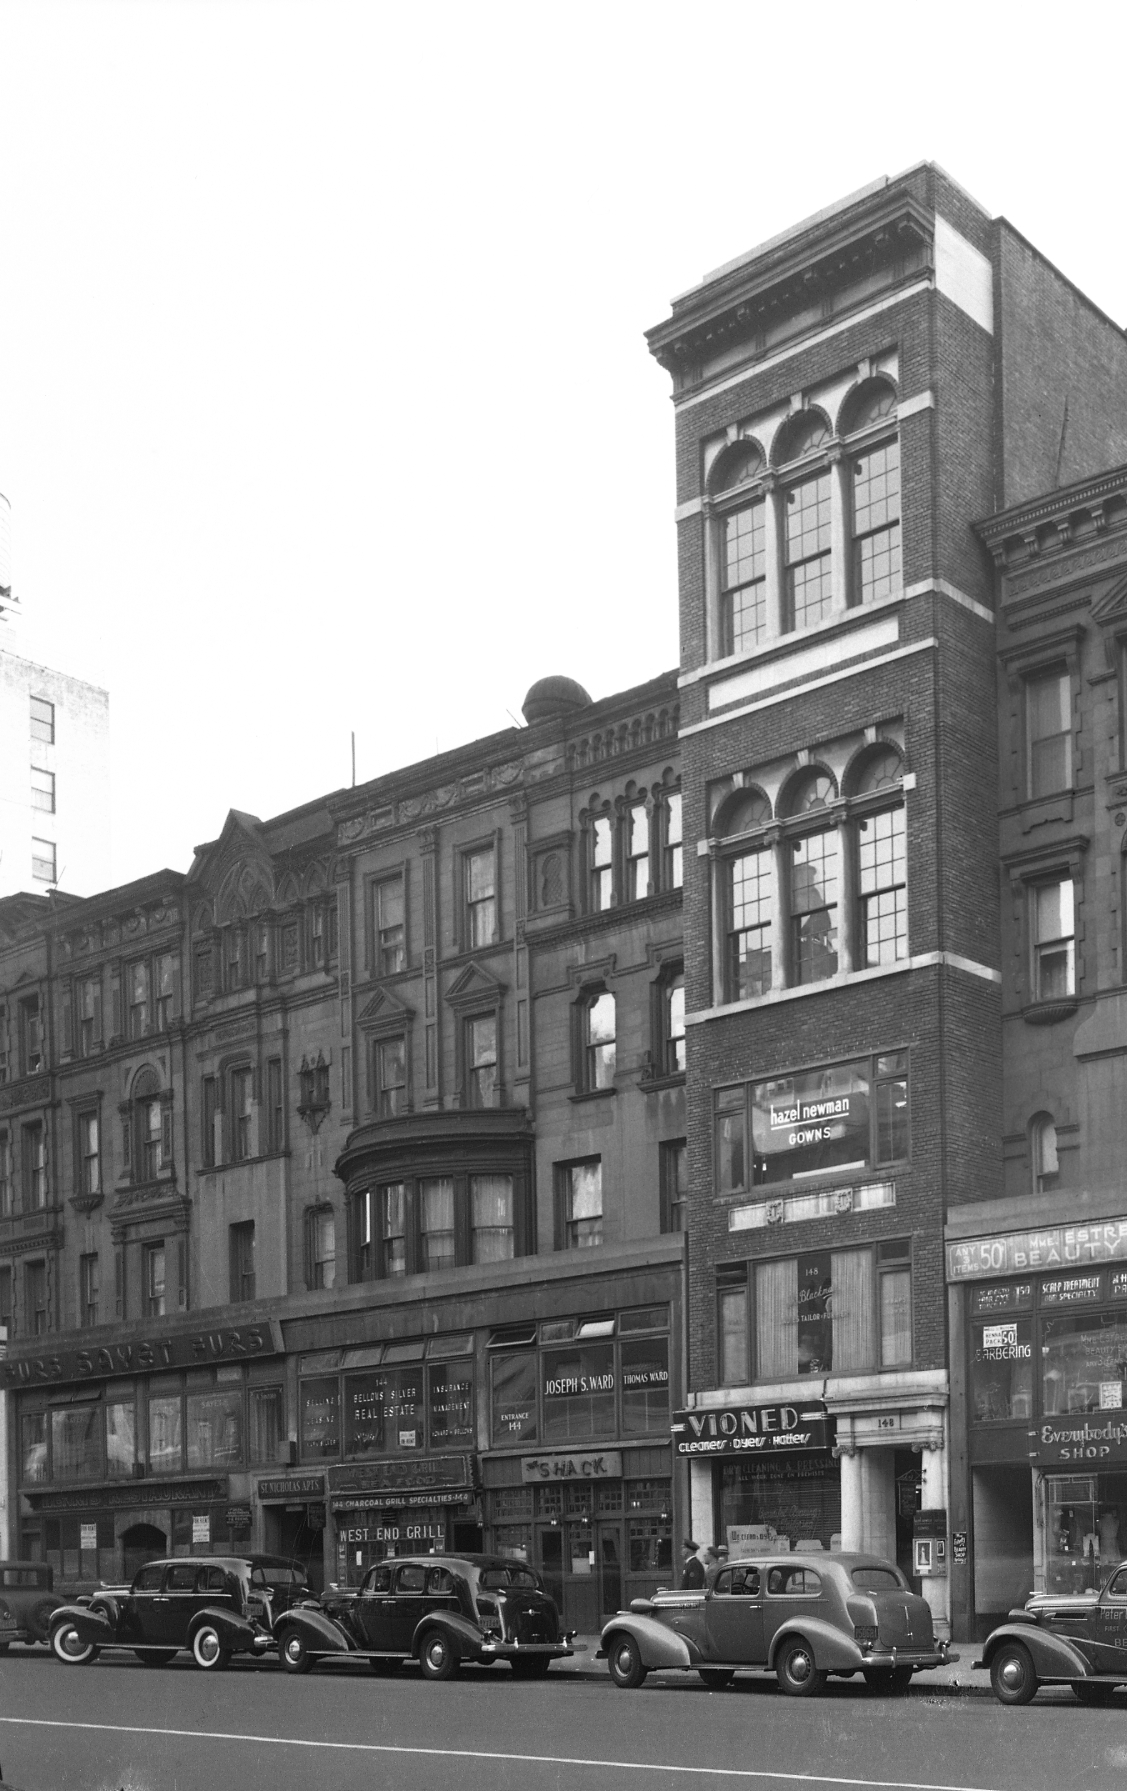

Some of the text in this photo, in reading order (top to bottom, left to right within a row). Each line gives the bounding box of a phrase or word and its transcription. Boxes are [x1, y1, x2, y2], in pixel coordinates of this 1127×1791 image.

[770, 1098, 849, 1125] hazel newman
[789, 1127, 831, 1145] GOWNS
[956, 1246, 976, 1256] ANY
[1015, 1238, 1121, 1267] BEAUTY
[963, 1256, 970, 1264] 3
[805, 1267, 819, 1276] 148
[953, 1264, 979, 1274] ITEMS
[1042, 1277, 1100, 1294] SCALP TREATMENT
[1059, 1289, 1097, 1300] SPECIALTY
[801, 1313, 820, 1321] TAILOR
[190, 1329, 264, 1358] FURS
[1086, 1346, 1115, 1355] BEAUTY
[544, 1374, 614, 1395] JOSEPH S. WARD
[623, 1371, 668, 1385] THOMAS WARD
[433, 1383, 469, 1394] INSURANCE
[354, 1388, 416, 1403] BELLOWS SILVER
[355, 1404, 415, 1420] REAL ESTATE
[433, 1401, 470, 1412] MANAGEMENT
[501, 1412, 530, 1421] ENTRANCE
[688, 1407, 798, 1436] VIONED
[878, 1418, 894, 1428] 148
[509, 1421, 521, 1431] 144
[1058, 1446, 1110, 1459] SHOP
[539, 1457, 607, 1478] SHACK
[742, 1462, 782, 1473] CLEANING
[797, 1458, 841, 1471] PRESSING
[270, 1480, 300, 1493] NICHOLAS
[345, 1499, 383, 1508] CHARCOAL
[385, 1497, 406, 1506] GRILL
[409, 1494, 452, 1504] SPECIALTIES
[340, 1525, 445, 1542] WEST END GRILL
[1101, 1607, 1123, 1619] Peter
